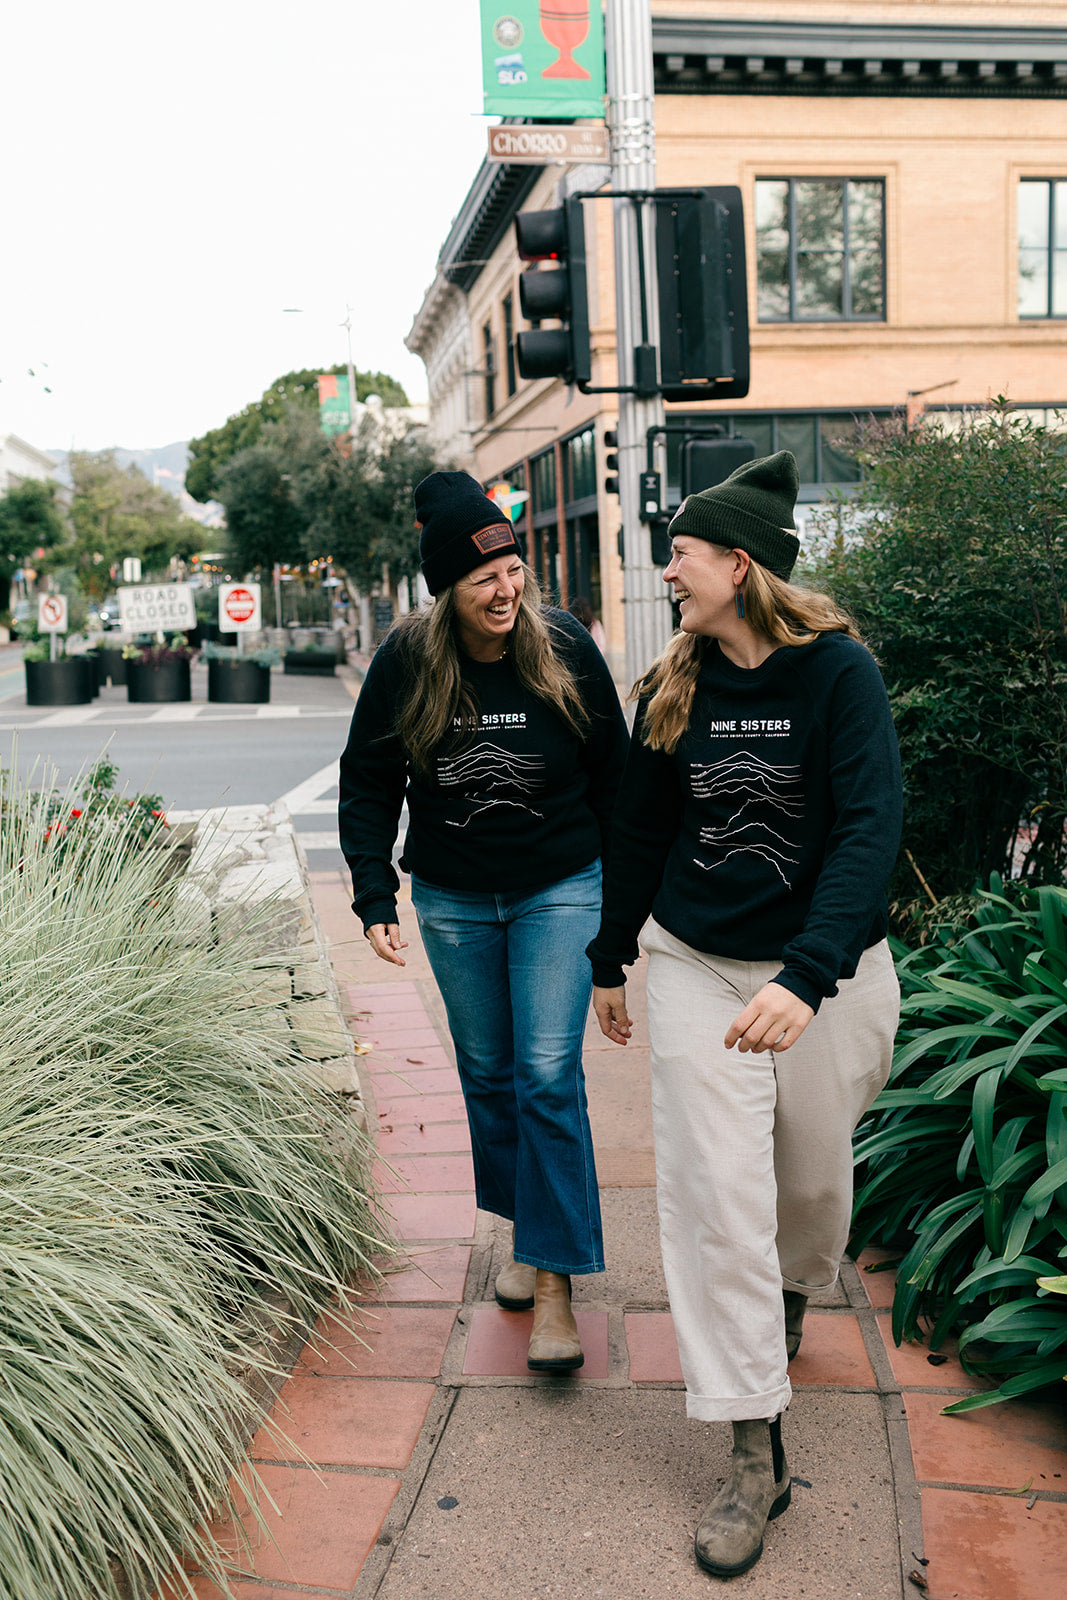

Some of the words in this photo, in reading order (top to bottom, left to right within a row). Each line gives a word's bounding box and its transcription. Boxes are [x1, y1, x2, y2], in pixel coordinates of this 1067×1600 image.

[132, 589, 178, 605] ROAD
[125, 602, 189, 621] CLOSED
[481, 713, 527, 725] SISTERS
[711, 720, 736, 731] NINE
[740, 719, 791, 731] SISTERS
